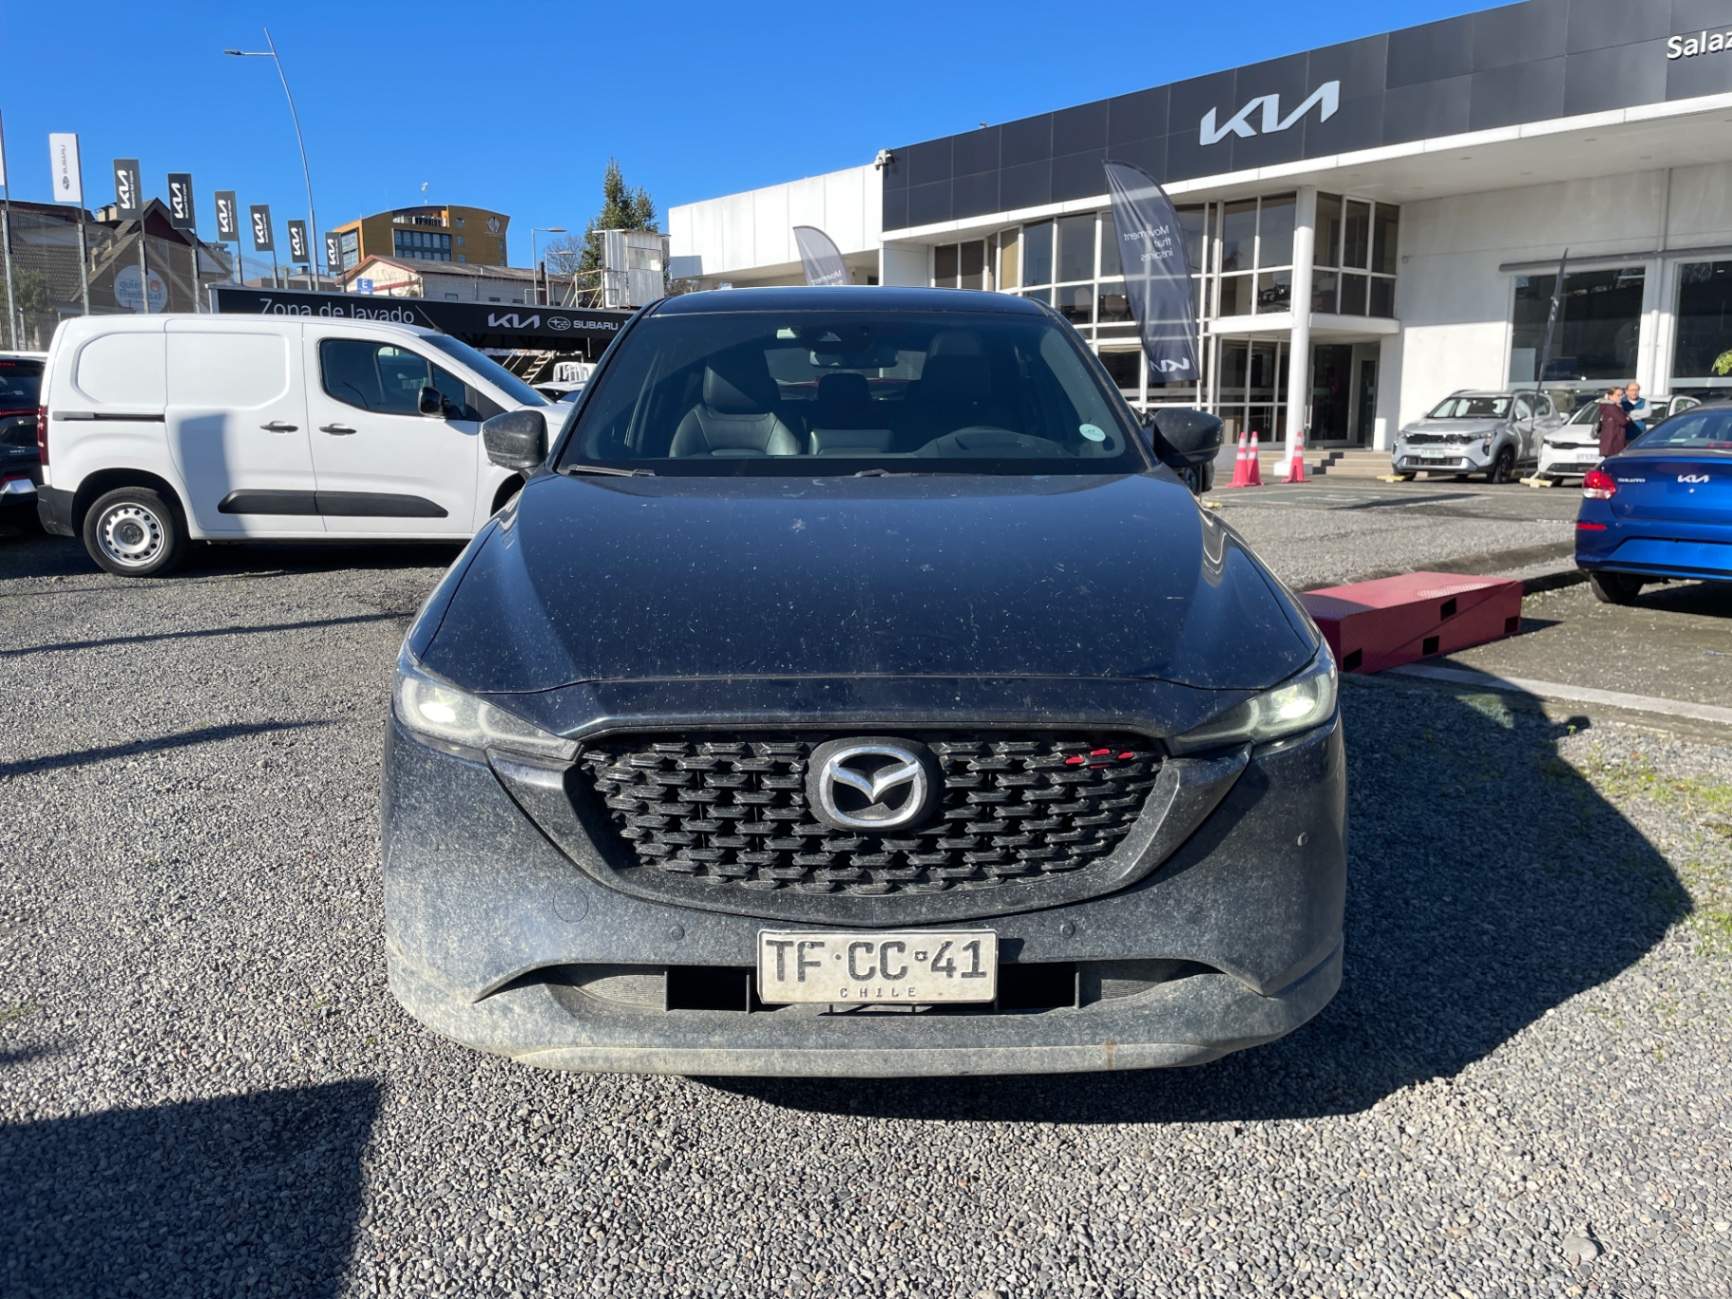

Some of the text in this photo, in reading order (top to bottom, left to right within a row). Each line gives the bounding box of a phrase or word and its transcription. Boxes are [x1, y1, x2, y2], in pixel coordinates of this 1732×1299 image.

[1199, 79, 1341, 146] KIA
[116, 169, 131, 209] KIA
[170, 183, 184, 219] KIA
[217, 199, 229, 233] KIA
[259, 298, 415, 324] Zona de lavado
[487, 312, 541, 329] KIA
[573, 319, 619, 330] SUBARU
[1677, 474, 1710, 483] KIA
[839, 987, 917, 998] CHILE
